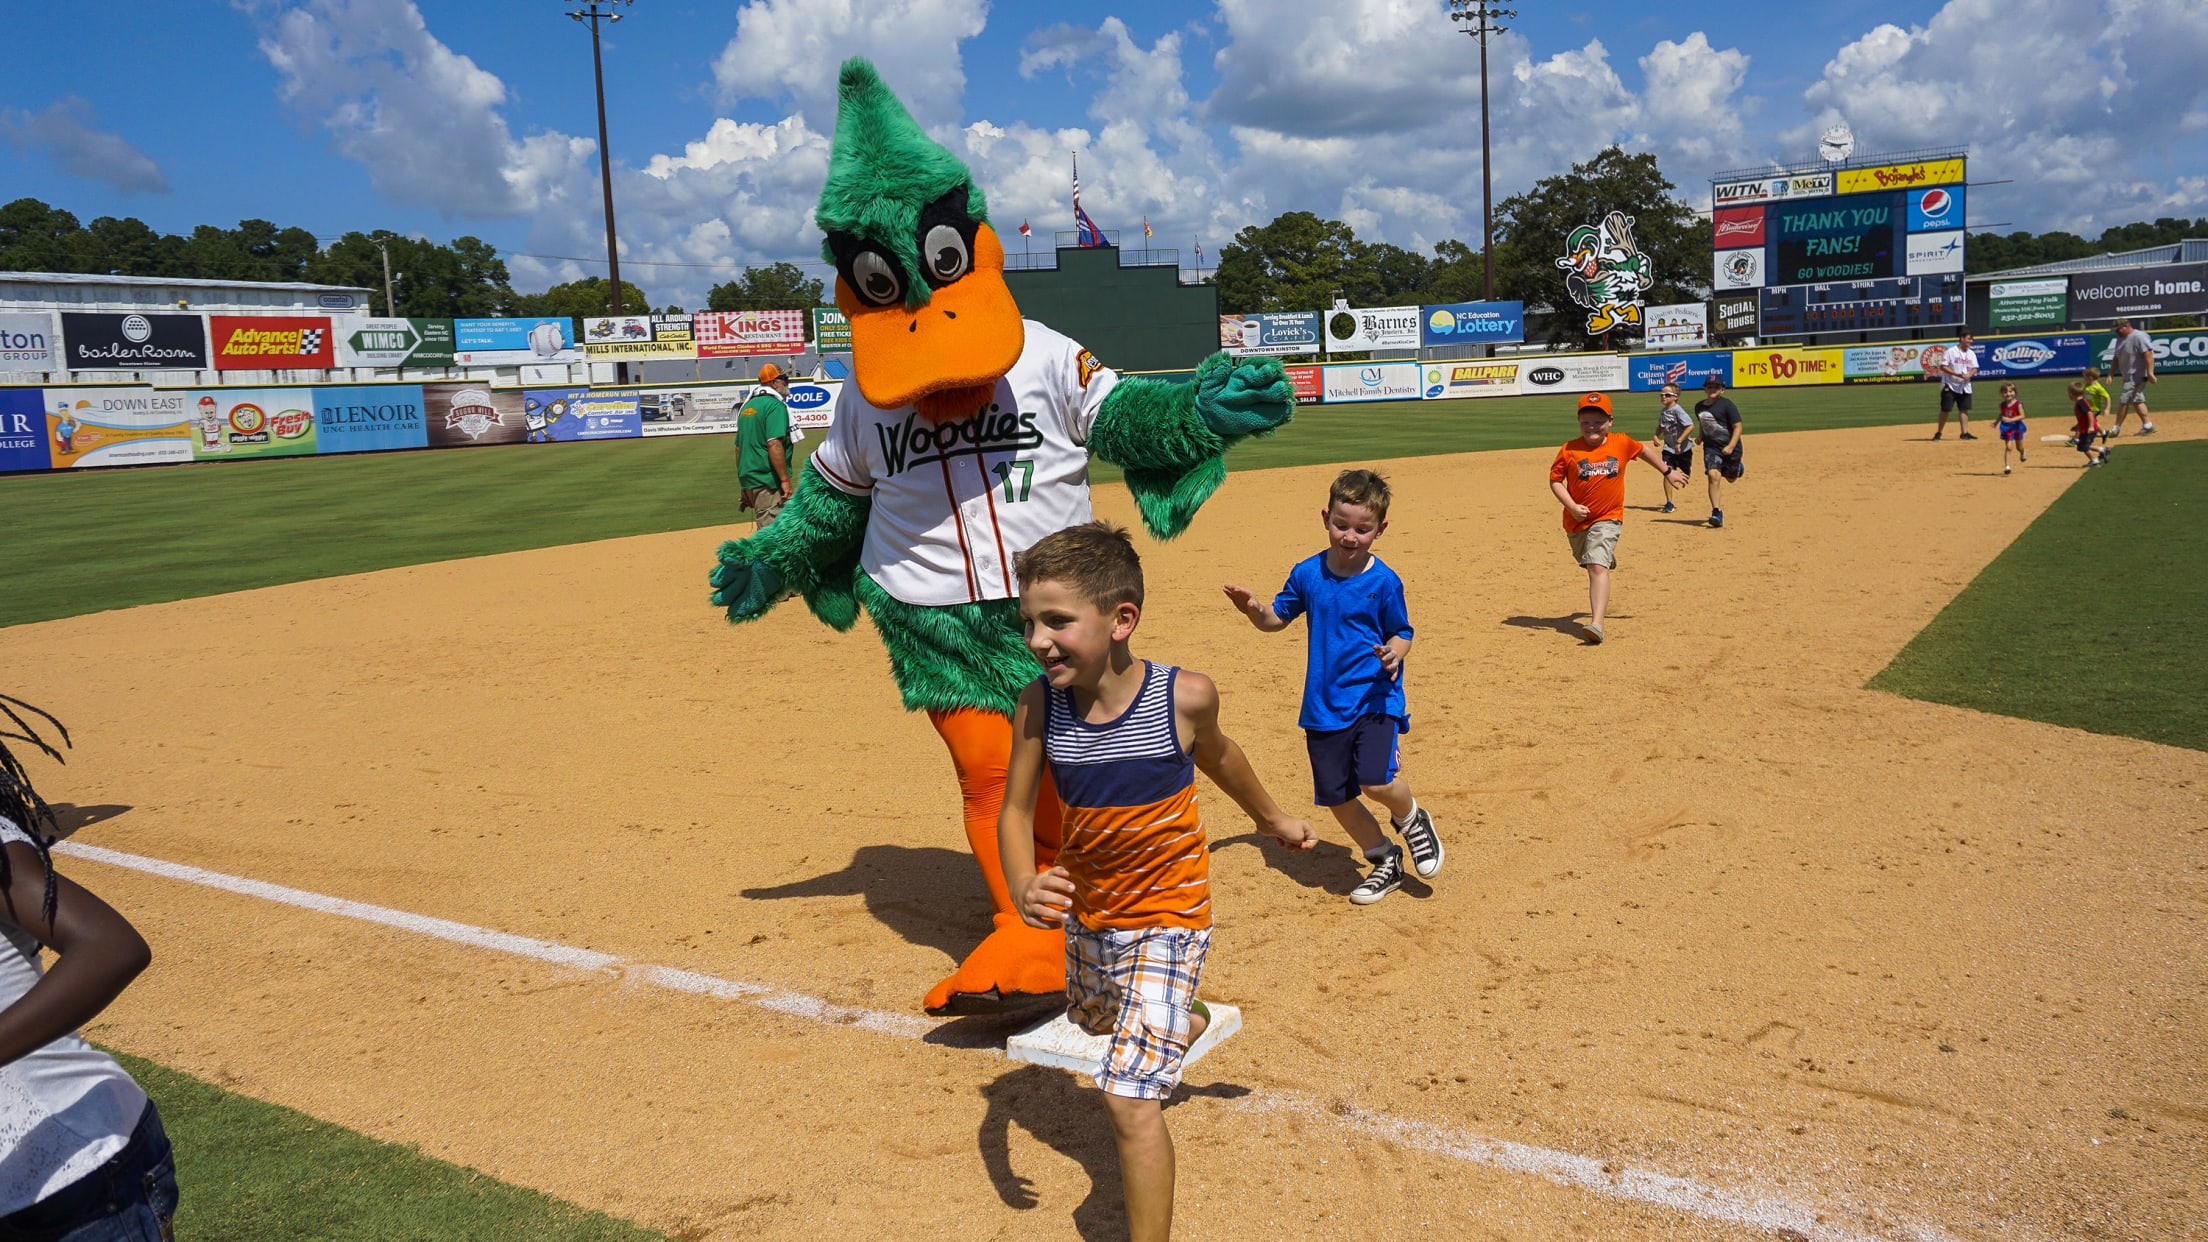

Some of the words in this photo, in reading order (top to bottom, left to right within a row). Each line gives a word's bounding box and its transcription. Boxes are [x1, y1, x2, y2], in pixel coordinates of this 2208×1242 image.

[1716, 183, 1762, 198] WITN
[1793, 177, 1829, 191] MeTV
[1721, 223, 1758, 231] Budweiser
[1783, 210, 1848, 233] THANK
[1851, 207, 1889, 227] YOU
[1806, 235, 1861, 257] FANS!
[1908, 251, 1944, 259] SPIRIT
[1798, 268, 1813, 279] GO
[1816, 263, 1874, 279] WOODIES!
[1814, 284, 1830, 292] BALL
[1852, 280, 1875, 289] STRIKE
[1898, 278, 1911, 286] OUT
[2075, 284, 2150, 301] welcome
[2154, 280, 2205, 296] home.
[1456, 312, 1467, 320] NC
[1719, 301, 1755, 320] SOCIAL
[651, 315, 664, 323] ALL
[665, 314, 693, 323] AROUND
[820, 312, 846, 325] JOIN
[1361, 315, 1417, 331] Barnes
[1727, 314, 1755, 330] HOUSE
[655, 322, 689, 332] STRENGTH
[718, 315, 782, 341] KINGS
[1271, 326, 1307, 336] Lovick's
[1456, 318, 1515, 335] Lottery
[229, 327, 297, 344] Advance
[361, 332, 406, 349] WIMCO
[221, 342, 259, 356] Auto
[258, 341, 297, 355] Parts
[585, 345, 609, 355] MILLS
[611, 343, 675, 353] INTERNATIONAL,
[677, 341, 693, 351] INC.
[1991, 346, 2057, 362] Stallings
[3, 352, 48, 361] GROUP
[2162, 359, 2184, 367] Rental
[1454, 366, 1517, 380] BALLPARK
[1748, 362, 1768, 376] IT'S
[1798, 359, 1827, 373] TIME!
[1532, 372, 1561, 382] WHC
[1637, 370, 1665, 380] Citizens
[1648, 378, 1666, 386] Bank
[620, 390, 638, 398] WITH
[785, 392, 824, 403] POOLE
[1328, 388, 1358, 399] Mitchell
[1359, 386, 1383, 397] Family
[1384, 384, 1416, 396] Dentistry
[103, 398, 147, 411] DOWN
[151, 397, 184, 410] EAST
[270, 410, 311, 427] Fresh
[336, 404, 418, 424] LENOIR
[275, 423, 303, 437] Buy
[349, 424, 390, 432] HEALTH
[394, 422, 420, 430] CARE
[875, 403, 1044, 477] Woodies
[992, 459, 1035, 503] 17
